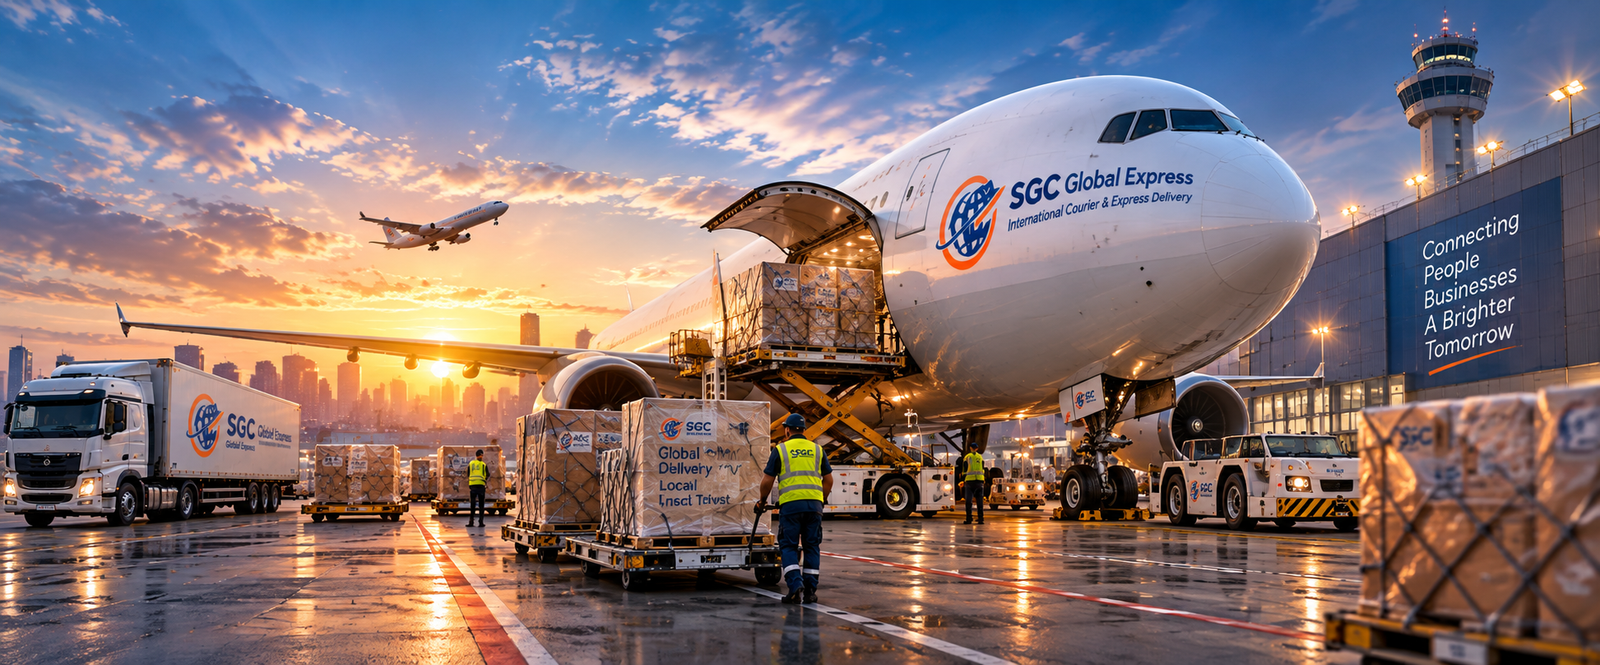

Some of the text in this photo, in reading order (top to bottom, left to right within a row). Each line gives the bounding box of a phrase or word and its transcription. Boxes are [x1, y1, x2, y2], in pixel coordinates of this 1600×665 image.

[1009, 167, 1194, 210] SGC Global Express
[1008, 192, 1193, 231] International Courier & Express Delivery
[1422, 213, 1520, 260] Connecting
[1424, 251, 1480, 285] People
[1424, 267, 1517, 309] Businesses
[1423, 296, 1515, 336] A Brighter
[1425, 323, 1514, 361] Tomorrow
[226, 413, 256, 440] SGC
[686, 421, 711, 432] SGC
[658, 446, 700, 460] Global
